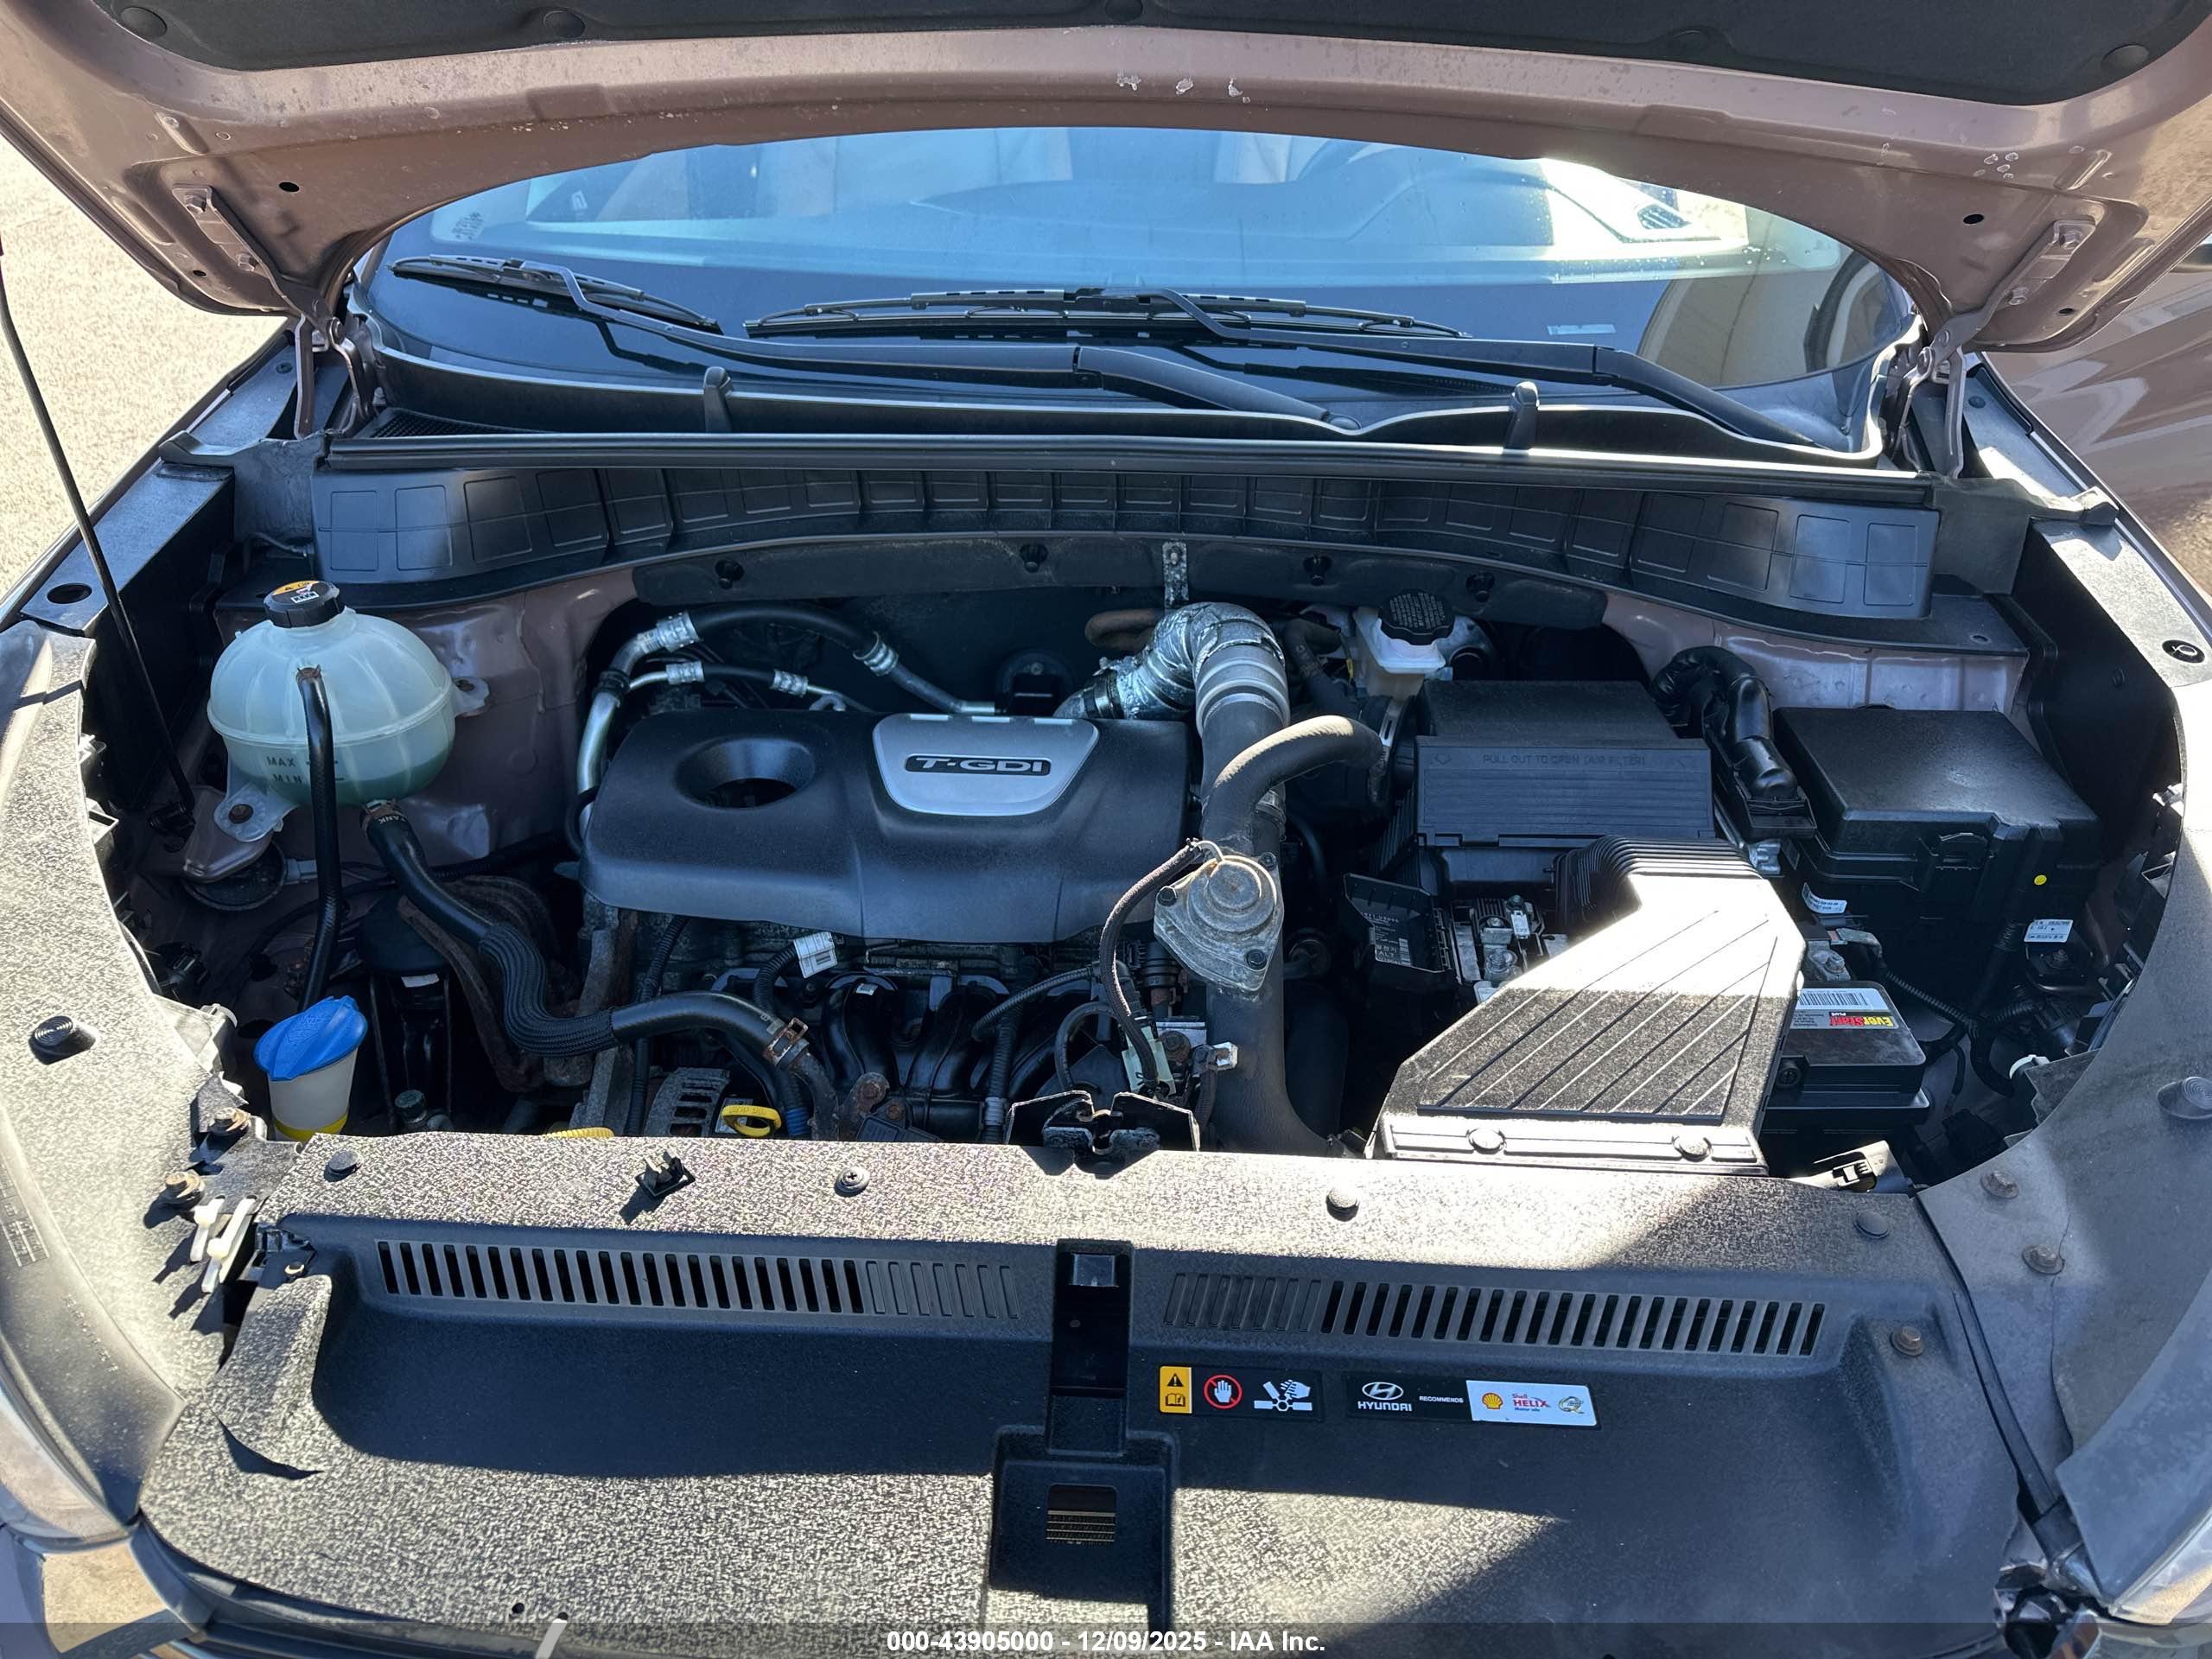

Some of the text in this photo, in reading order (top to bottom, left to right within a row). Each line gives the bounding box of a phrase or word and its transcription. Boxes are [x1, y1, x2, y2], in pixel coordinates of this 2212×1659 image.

[266, 756, 296, 767] MAX
[916, 757, 1043, 772] T-GDI
[273, 773, 302, 784] MIN
[1831, 1017, 1893, 1027] EverStart
[1419, 1395, 1465, 1404] RECOMMENDS
[1513, 1399, 1549, 1408] HELIX
[1357, 1401, 1413, 1412] HYUNDAI
